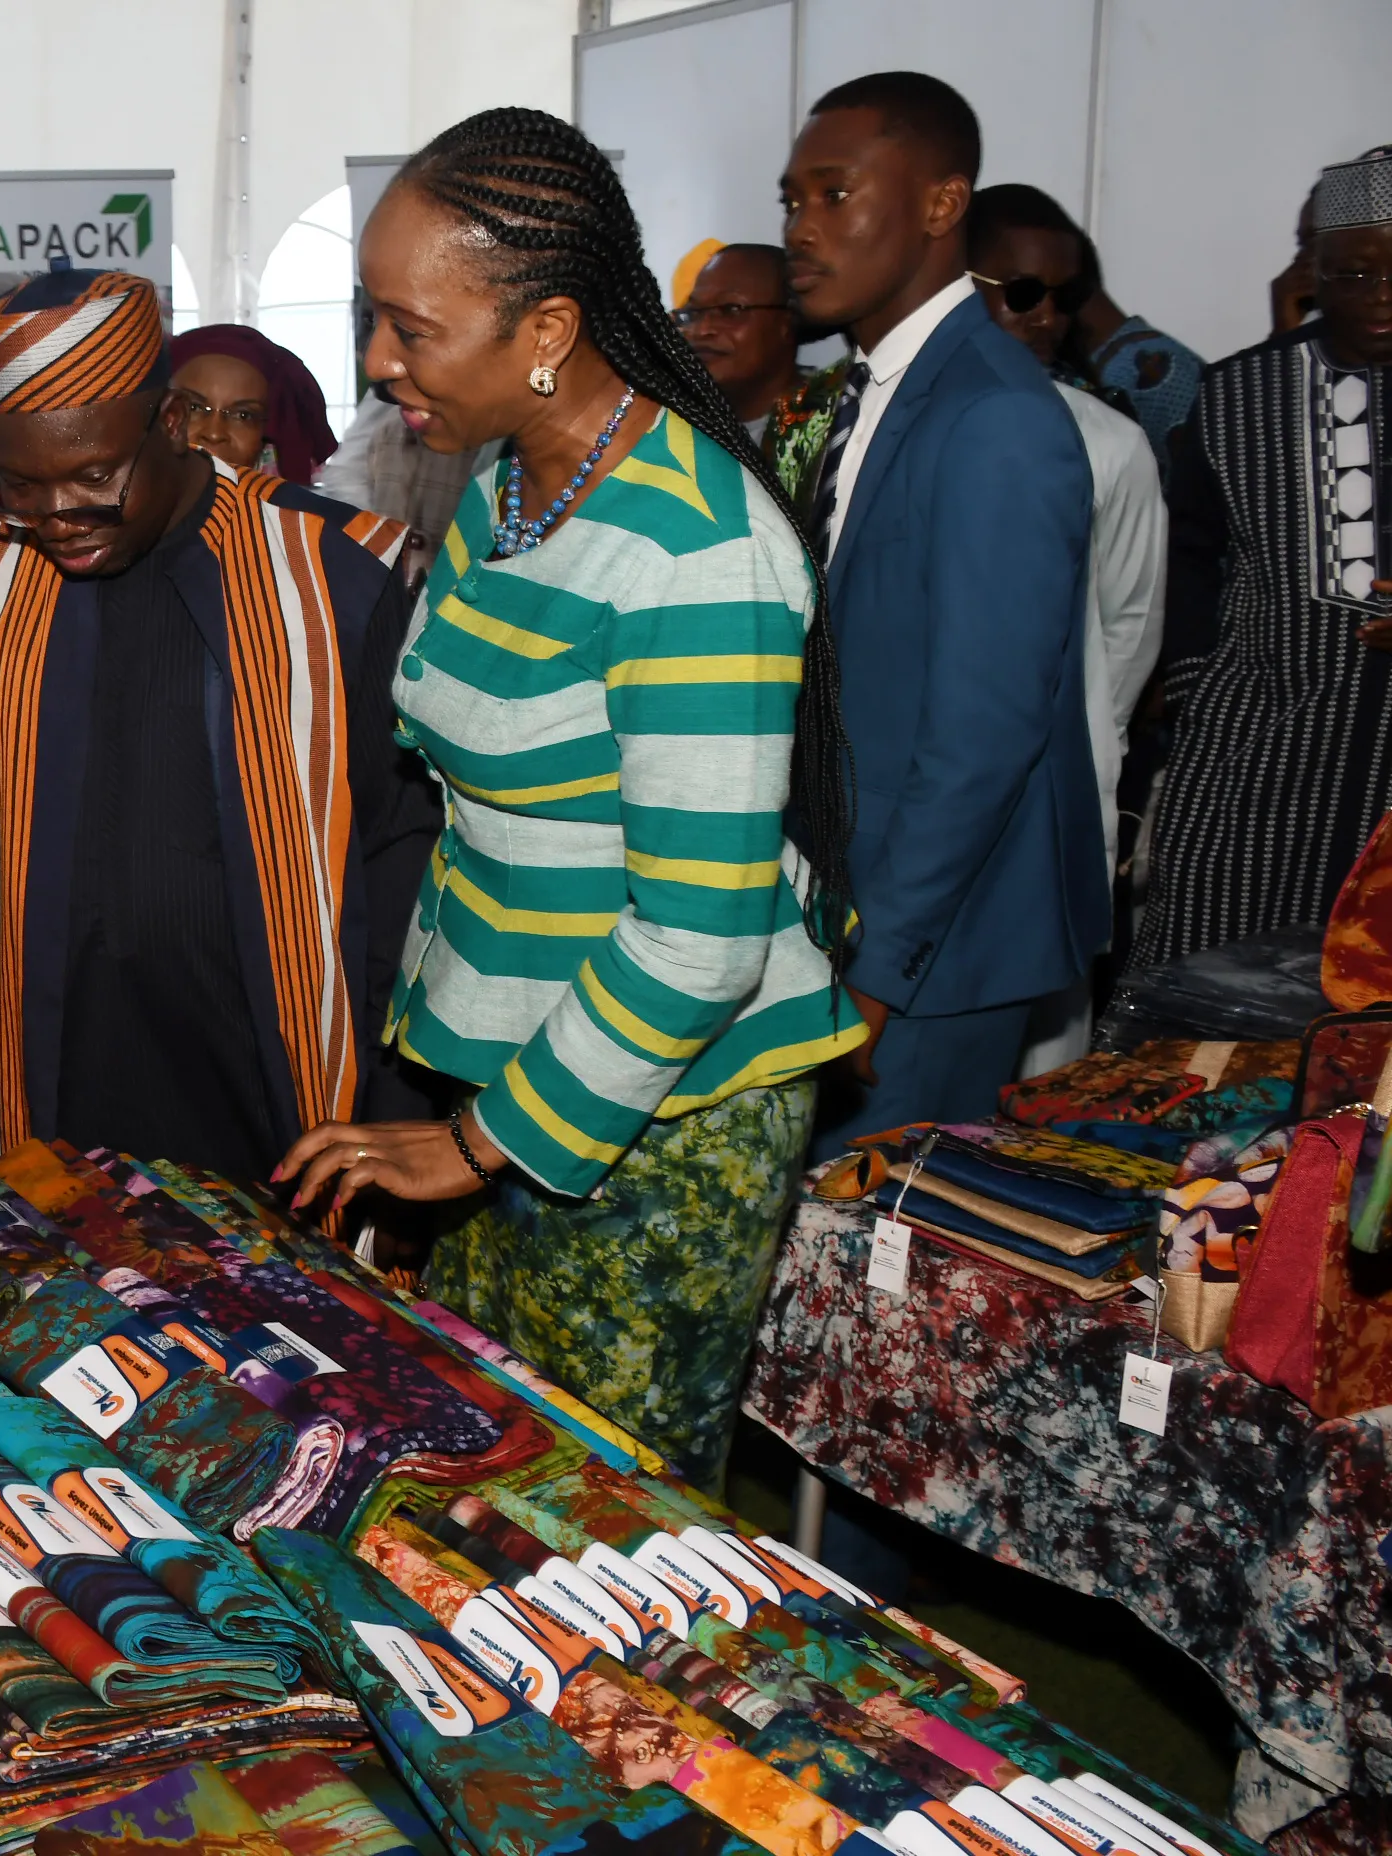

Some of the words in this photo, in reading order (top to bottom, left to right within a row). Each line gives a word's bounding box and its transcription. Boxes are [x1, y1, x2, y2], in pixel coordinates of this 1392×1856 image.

[114, 1348, 134, 1366] Unique
[133, 1362, 152, 1379] Soyez
[78, 1366, 109, 1394] Merveilleuse
[68, 1490, 89, 1512] Soyez
[88, 1507, 114, 1532] Unique
[5, 1526, 28, 1550] Unique
[598, 1564, 646, 1600] Merveilleuse
[656, 1554, 705, 1590] Merveilleuse
[531, 1596, 580, 1632] Merveilleuse
[553, 1579, 600, 1618] Merveilleuse
[470, 1628, 518, 1664] Merveilleuse
[480, 1646, 512, 1673] Créature
[392, 1640, 434, 1690] Merveilleuse
[397, 1655, 426, 1689] Créature
[431, 1656, 460, 1682] Unique
[450, 1661, 468, 1676] coton
[460, 1681, 488, 1702] Soyez
[468, 1675, 485, 1690] 100%
[1032, 1796, 1106, 1841] Merveilleuse
[948, 1819, 992, 1852] Unique
